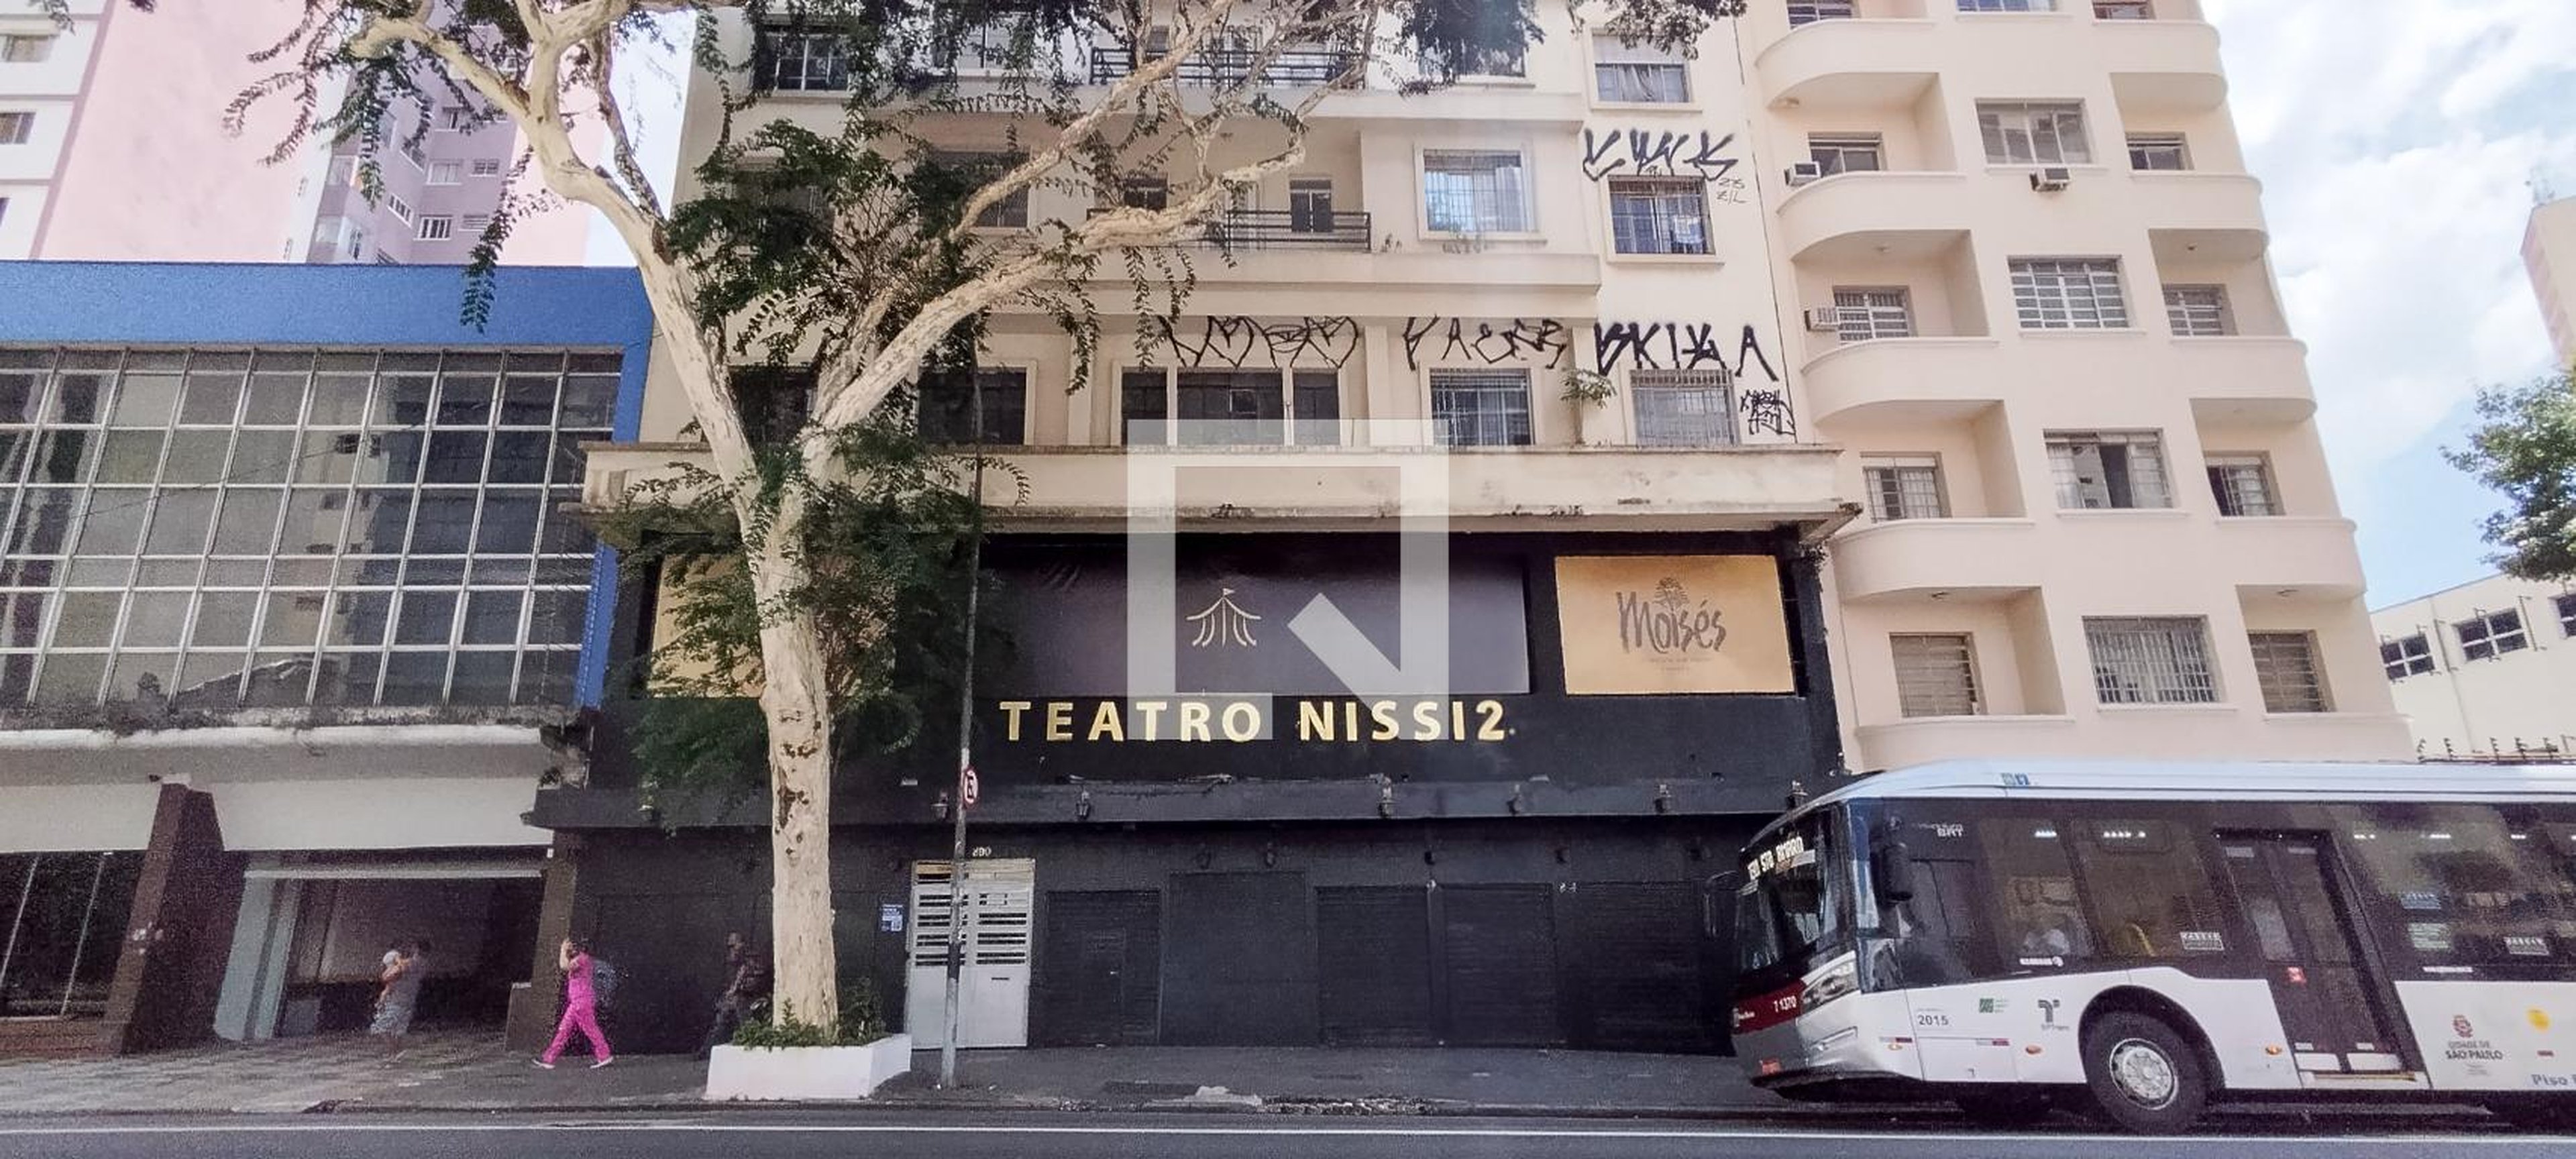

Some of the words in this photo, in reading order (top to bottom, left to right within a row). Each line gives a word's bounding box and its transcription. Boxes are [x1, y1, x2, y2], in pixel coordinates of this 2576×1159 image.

[1615, 591, 1727, 654] Moisés
[1000, 700, 1263, 742] TEATRO
[1299, 700, 1507, 742] NISSI2
[1918, 1014, 1949, 1026] 2015
[2468, 1049, 2504, 1060] PAULO
[2530, 1073, 2569, 1087] Piso
